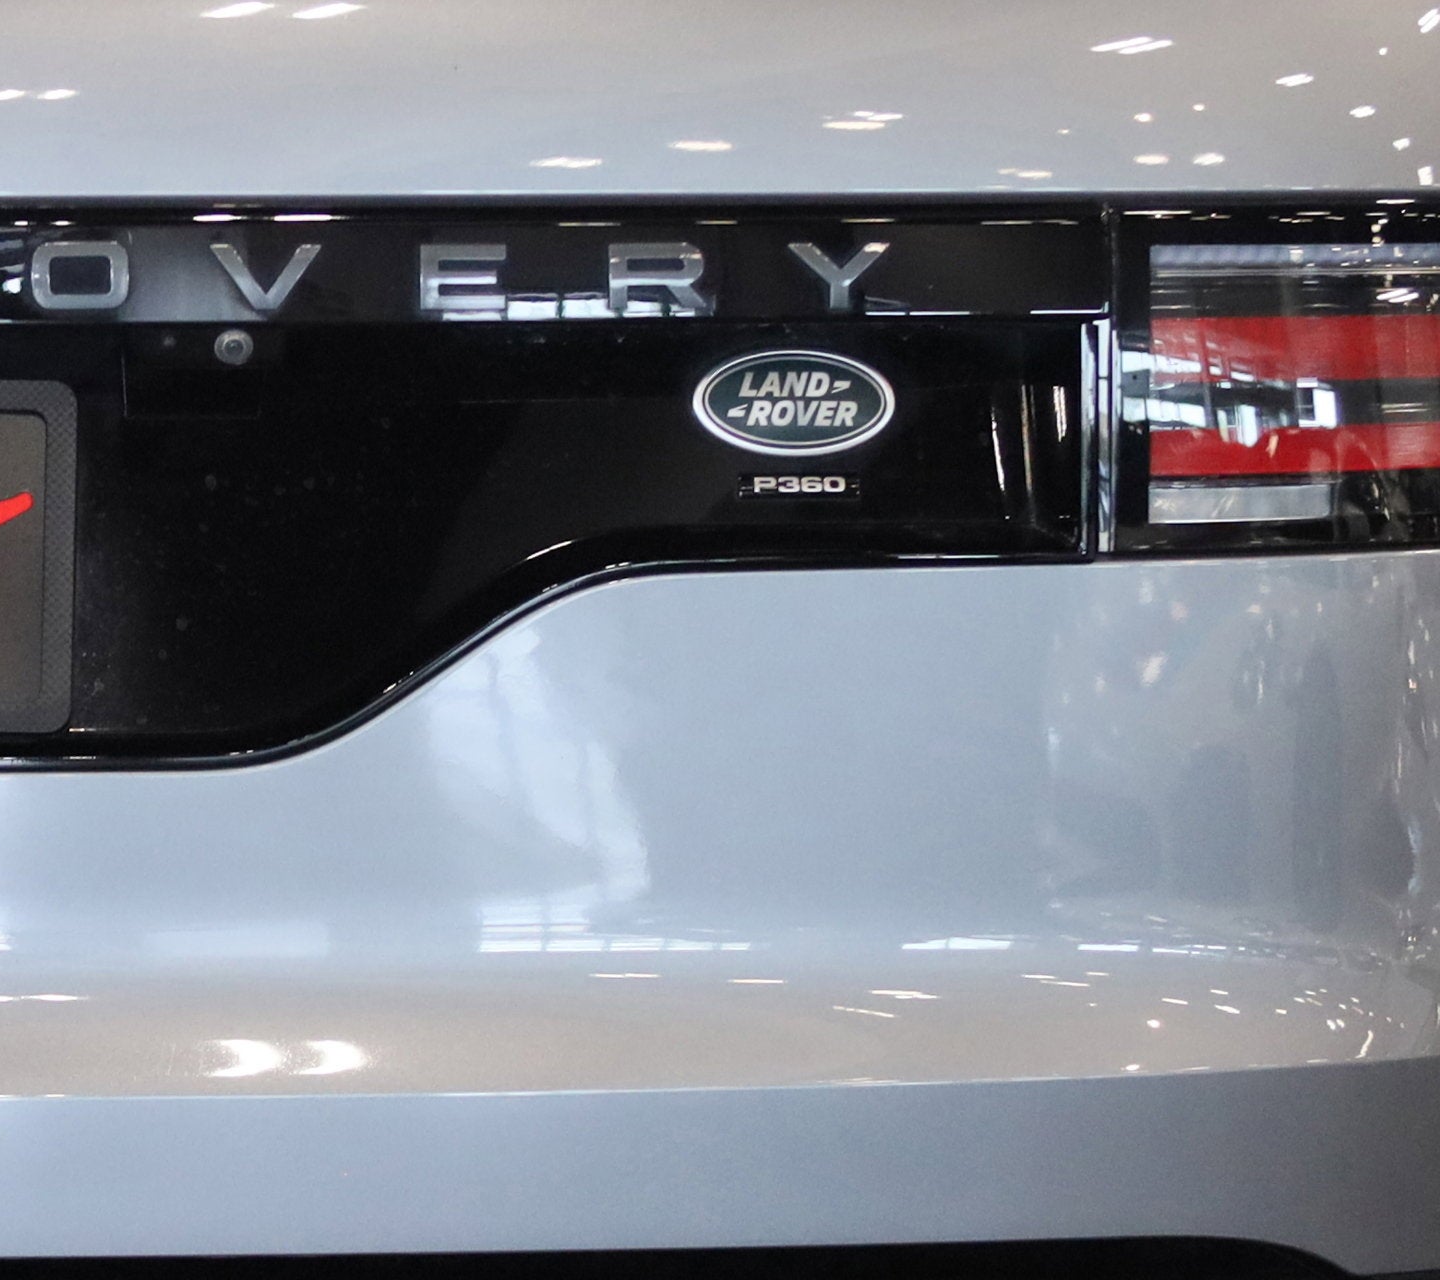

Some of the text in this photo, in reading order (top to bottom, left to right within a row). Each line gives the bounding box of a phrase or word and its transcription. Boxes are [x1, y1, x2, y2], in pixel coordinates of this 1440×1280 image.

[738, 371, 829, 398] LAND
[746, 400, 859, 427] ROVER
[752, 476, 846, 494] P360
